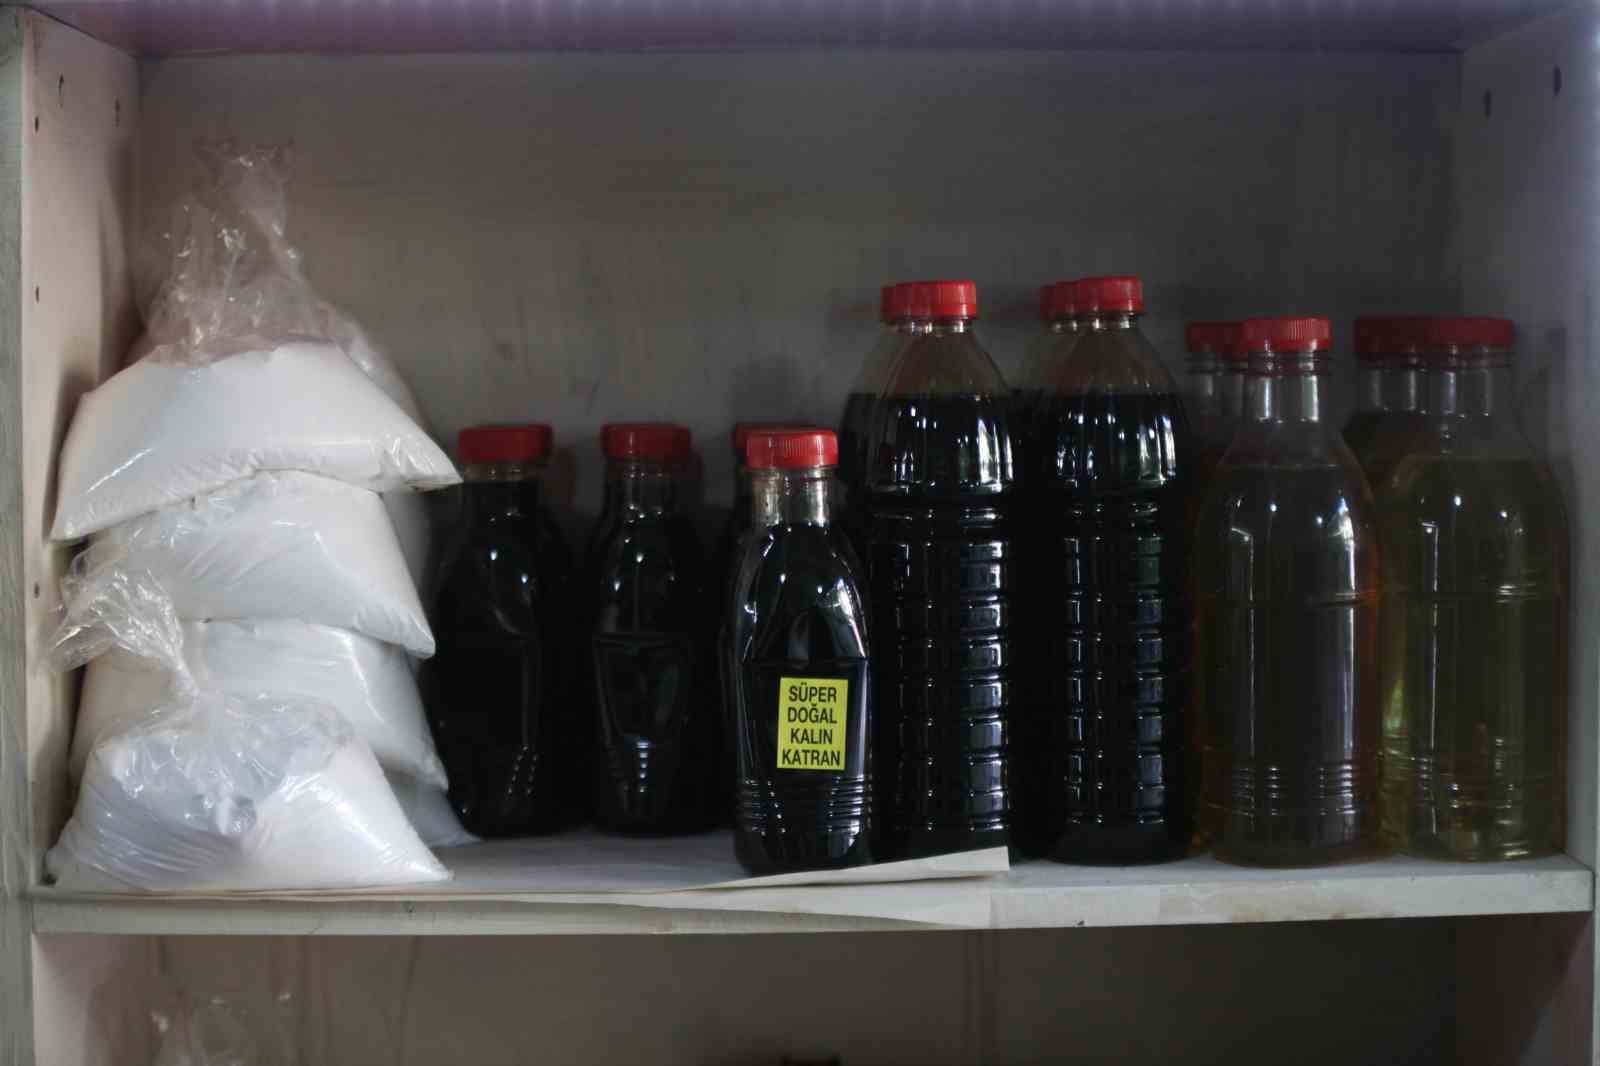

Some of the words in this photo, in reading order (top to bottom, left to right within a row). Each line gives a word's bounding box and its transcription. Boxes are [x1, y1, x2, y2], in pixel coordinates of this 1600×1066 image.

[788, 682, 837, 703] SÜPER
[787, 703, 838, 724] DOĞAL
[790, 728, 833, 745] KALIN
[782, 749, 841, 766] KATRAN
